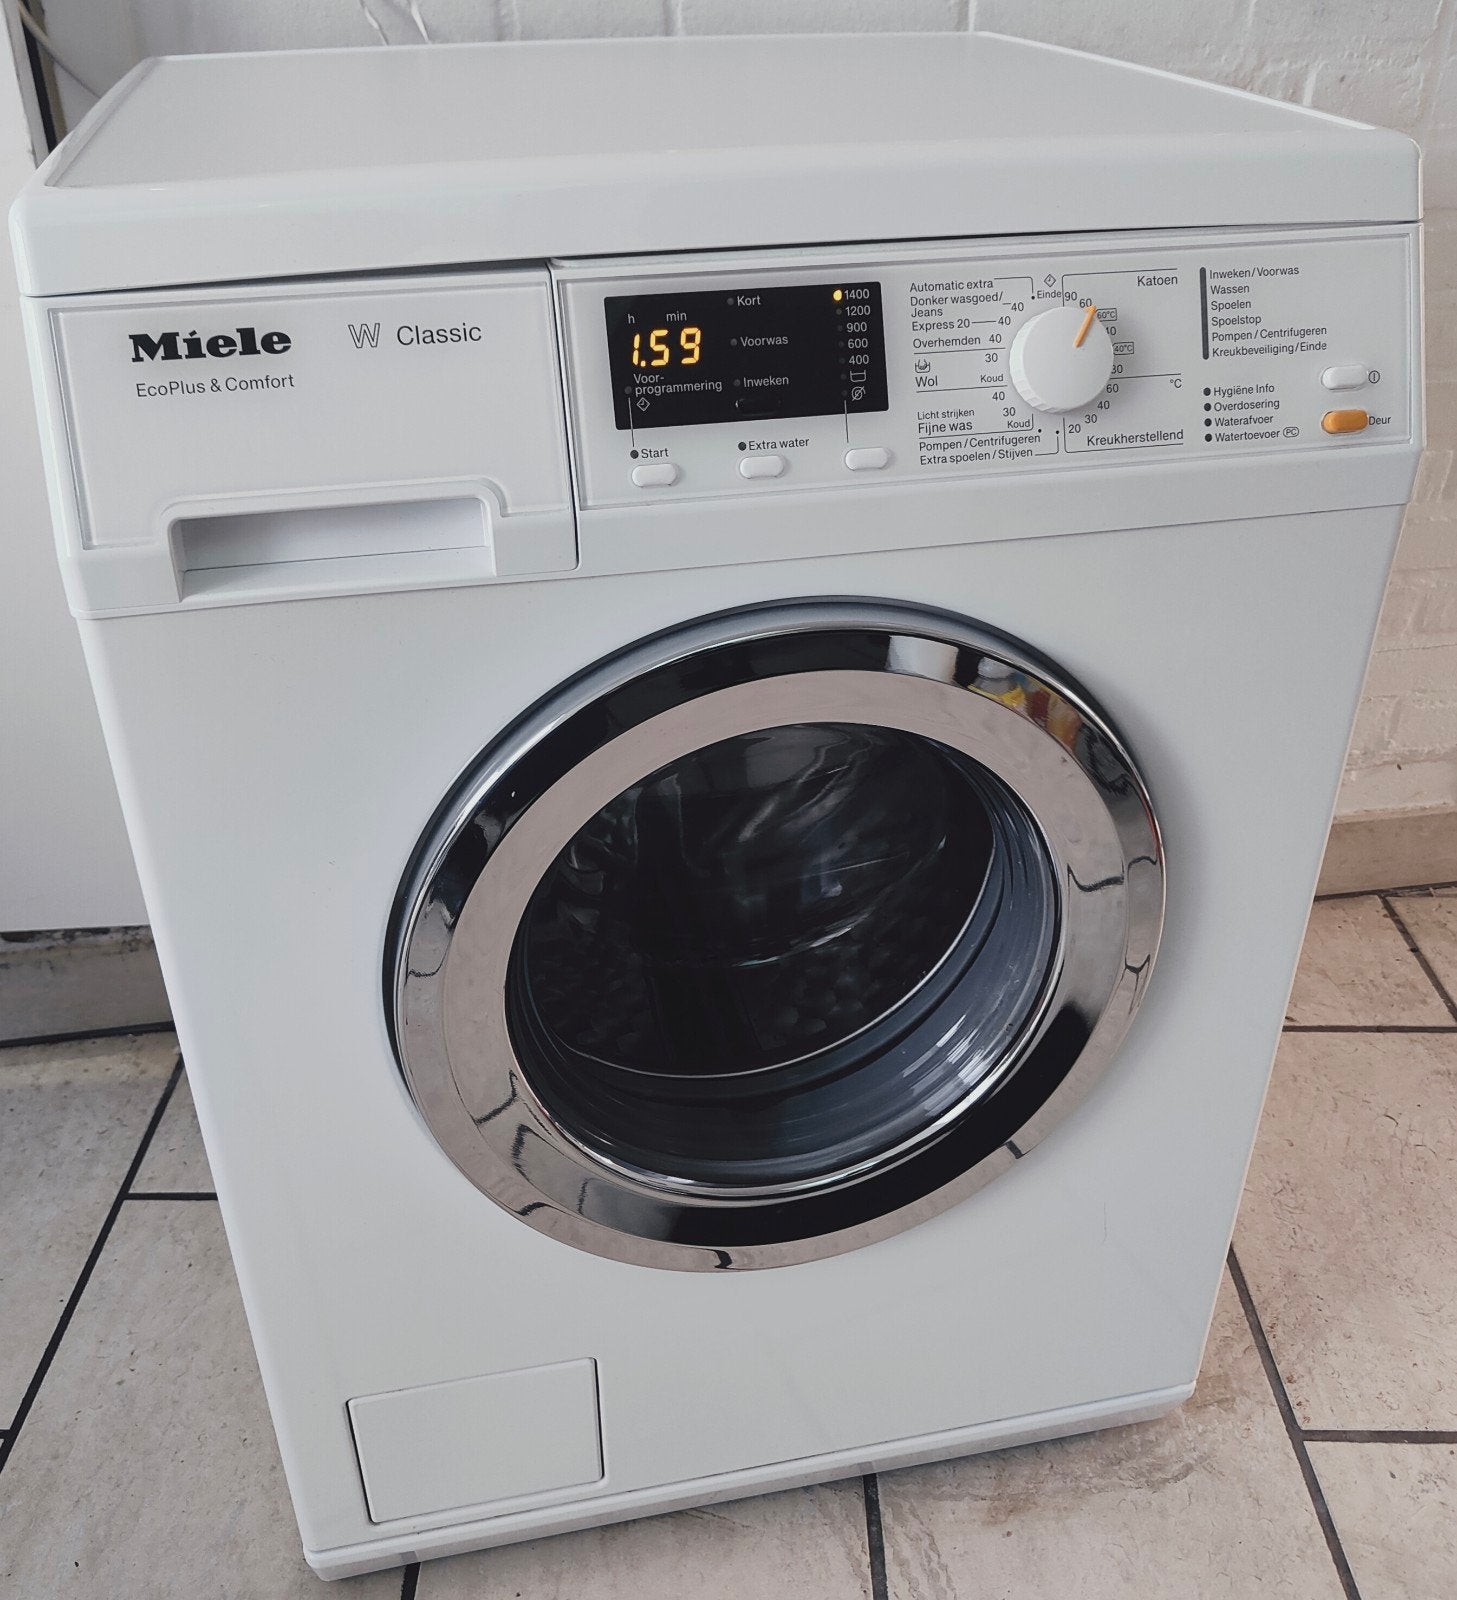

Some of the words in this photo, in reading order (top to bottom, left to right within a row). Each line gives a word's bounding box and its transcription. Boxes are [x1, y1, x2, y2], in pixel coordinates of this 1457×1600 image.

[910, 281, 964, 292] Automatic
[967, 280, 994, 289] extra
[1137, 276, 1178, 287] Katoen
[844, 289, 870, 300] 1400
[1037, 290, 1062, 299] Einde
[1211, 285, 1250, 295] Wassen
[737, 295, 761, 306] Kort
[911, 296, 948, 306] Donker
[951, 292, 1004, 305] wasgoed/
[1065, 292, 1078, 301] 90
[1011, 302, 1024, 312] 40
[1080, 298, 1092, 308] 60
[1211, 300, 1252, 312] Spoelen
[845, 305, 871, 316] 1200
[911, 308, 943, 318] Jeans
[628, 314, 635, 324] h
[666, 311, 687, 322] min
[998, 316, 1011, 325] 40
[1212, 315, 1262, 328] Spoelstop
[847, 322, 867, 332] 900
[912, 321, 954, 333] Express
[957, 319, 970, 329] 20
[348, 323, 380, 349] W
[397, 322, 482, 346] Classic
[740, 335, 789, 347] Voorwas
[989, 334, 1002, 343] 40
[129, 328, 292, 363] Miele
[632, 327, 701, 367] 1.59
[848, 339, 868, 349] 600
[913, 336, 980, 348] Overhemden
[849, 355, 869, 365] 400
[985, 353, 998, 362] 30
[634, 374, 664, 384] Voor-
[743, 376, 789, 388] Inweken
[915, 376, 938, 387] Wol
[980, 374, 1004, 383] Koud
[136, 379, 205, 398] EcoPlus
[210, 378, 222, 392] &
[226, 374, 295, 391] Comfort
[635, 380, 723, 398] programmering
[1106, 384, 1119, 393] 60
[1214, 386, 1254, 399] Hygiëne
[1256, 384, 1275, 394] Info
[992, 392, 1005, 401] 40
[1097, 401, 1110, 410] 40
[1214, 399, 1280, 412] Overdosering
[918, 411, 940, 420] Licht
[942, 409, 975, 420] strijken
[1003, 407, 1015, 417] 30
[1008, 420, 1030, 429] Koud
[1085, 414, 1098, 424] 30
[1215, 415, 1274, 427] Waterafvoer
[1369, 416, 1391, 425] Deur
[918, 422, 947, 436] Fijne
[948, 421, 973, 431] was
[1068, 424, 1081, 434] 20
[1087, 429, 1184, 447] Kreukherstellend
[1215, 430, 1280, 443] Watertoevoer
[749, 440, 777, 451] Extra
[779, 438, 810, 449] water
[641, 448, 669, 459] Start
[920, 455, 947, 465] Extra
